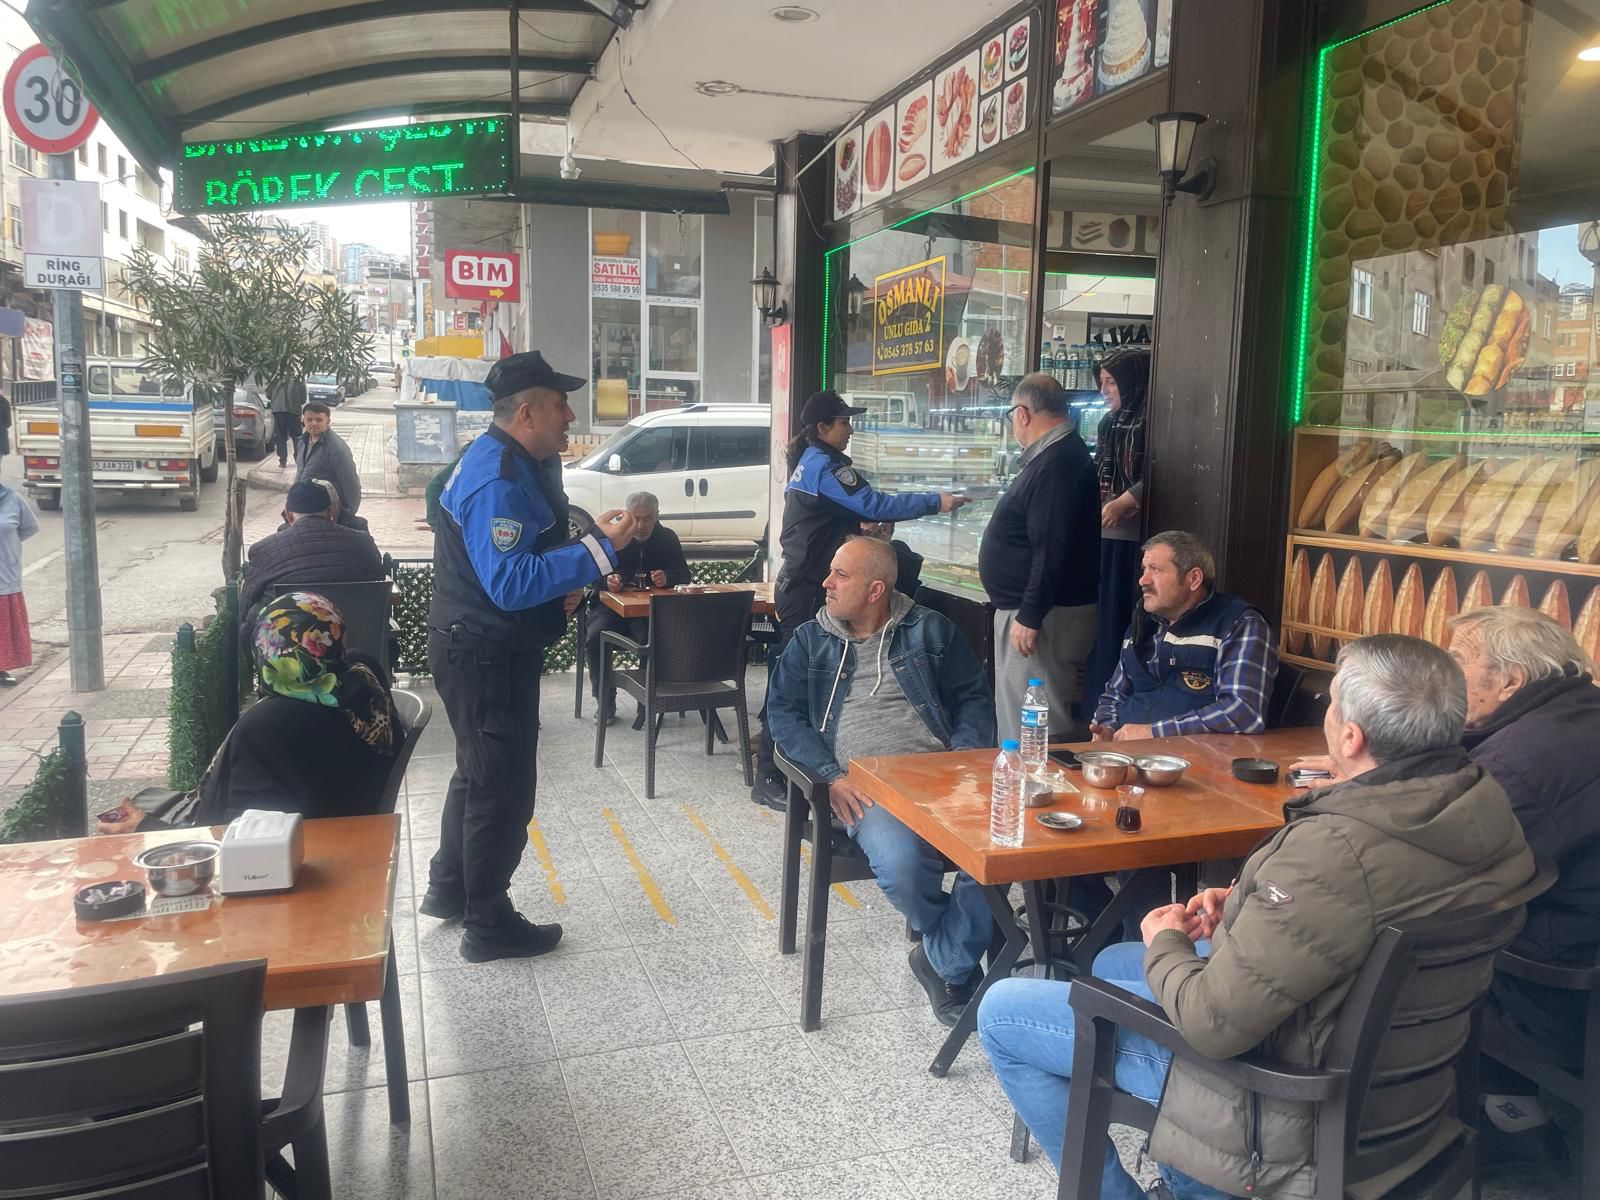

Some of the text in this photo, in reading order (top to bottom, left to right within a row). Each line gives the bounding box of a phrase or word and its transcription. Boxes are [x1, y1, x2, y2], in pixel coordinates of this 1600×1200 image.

[24, 76, 81, 126] 30
[46, 258, 81, 272] RİNG
[593, 263, 638, 276] SATILIK
[37, 272, 91, 286] DURAĞI
[878, 276, 940, 326] OSMANLI
[924, 311, 932, 333] 2
[883, 344, 900, 360] 0545
[914, 341, 924, 354] 57
[924, 339, 934, 353] 63
